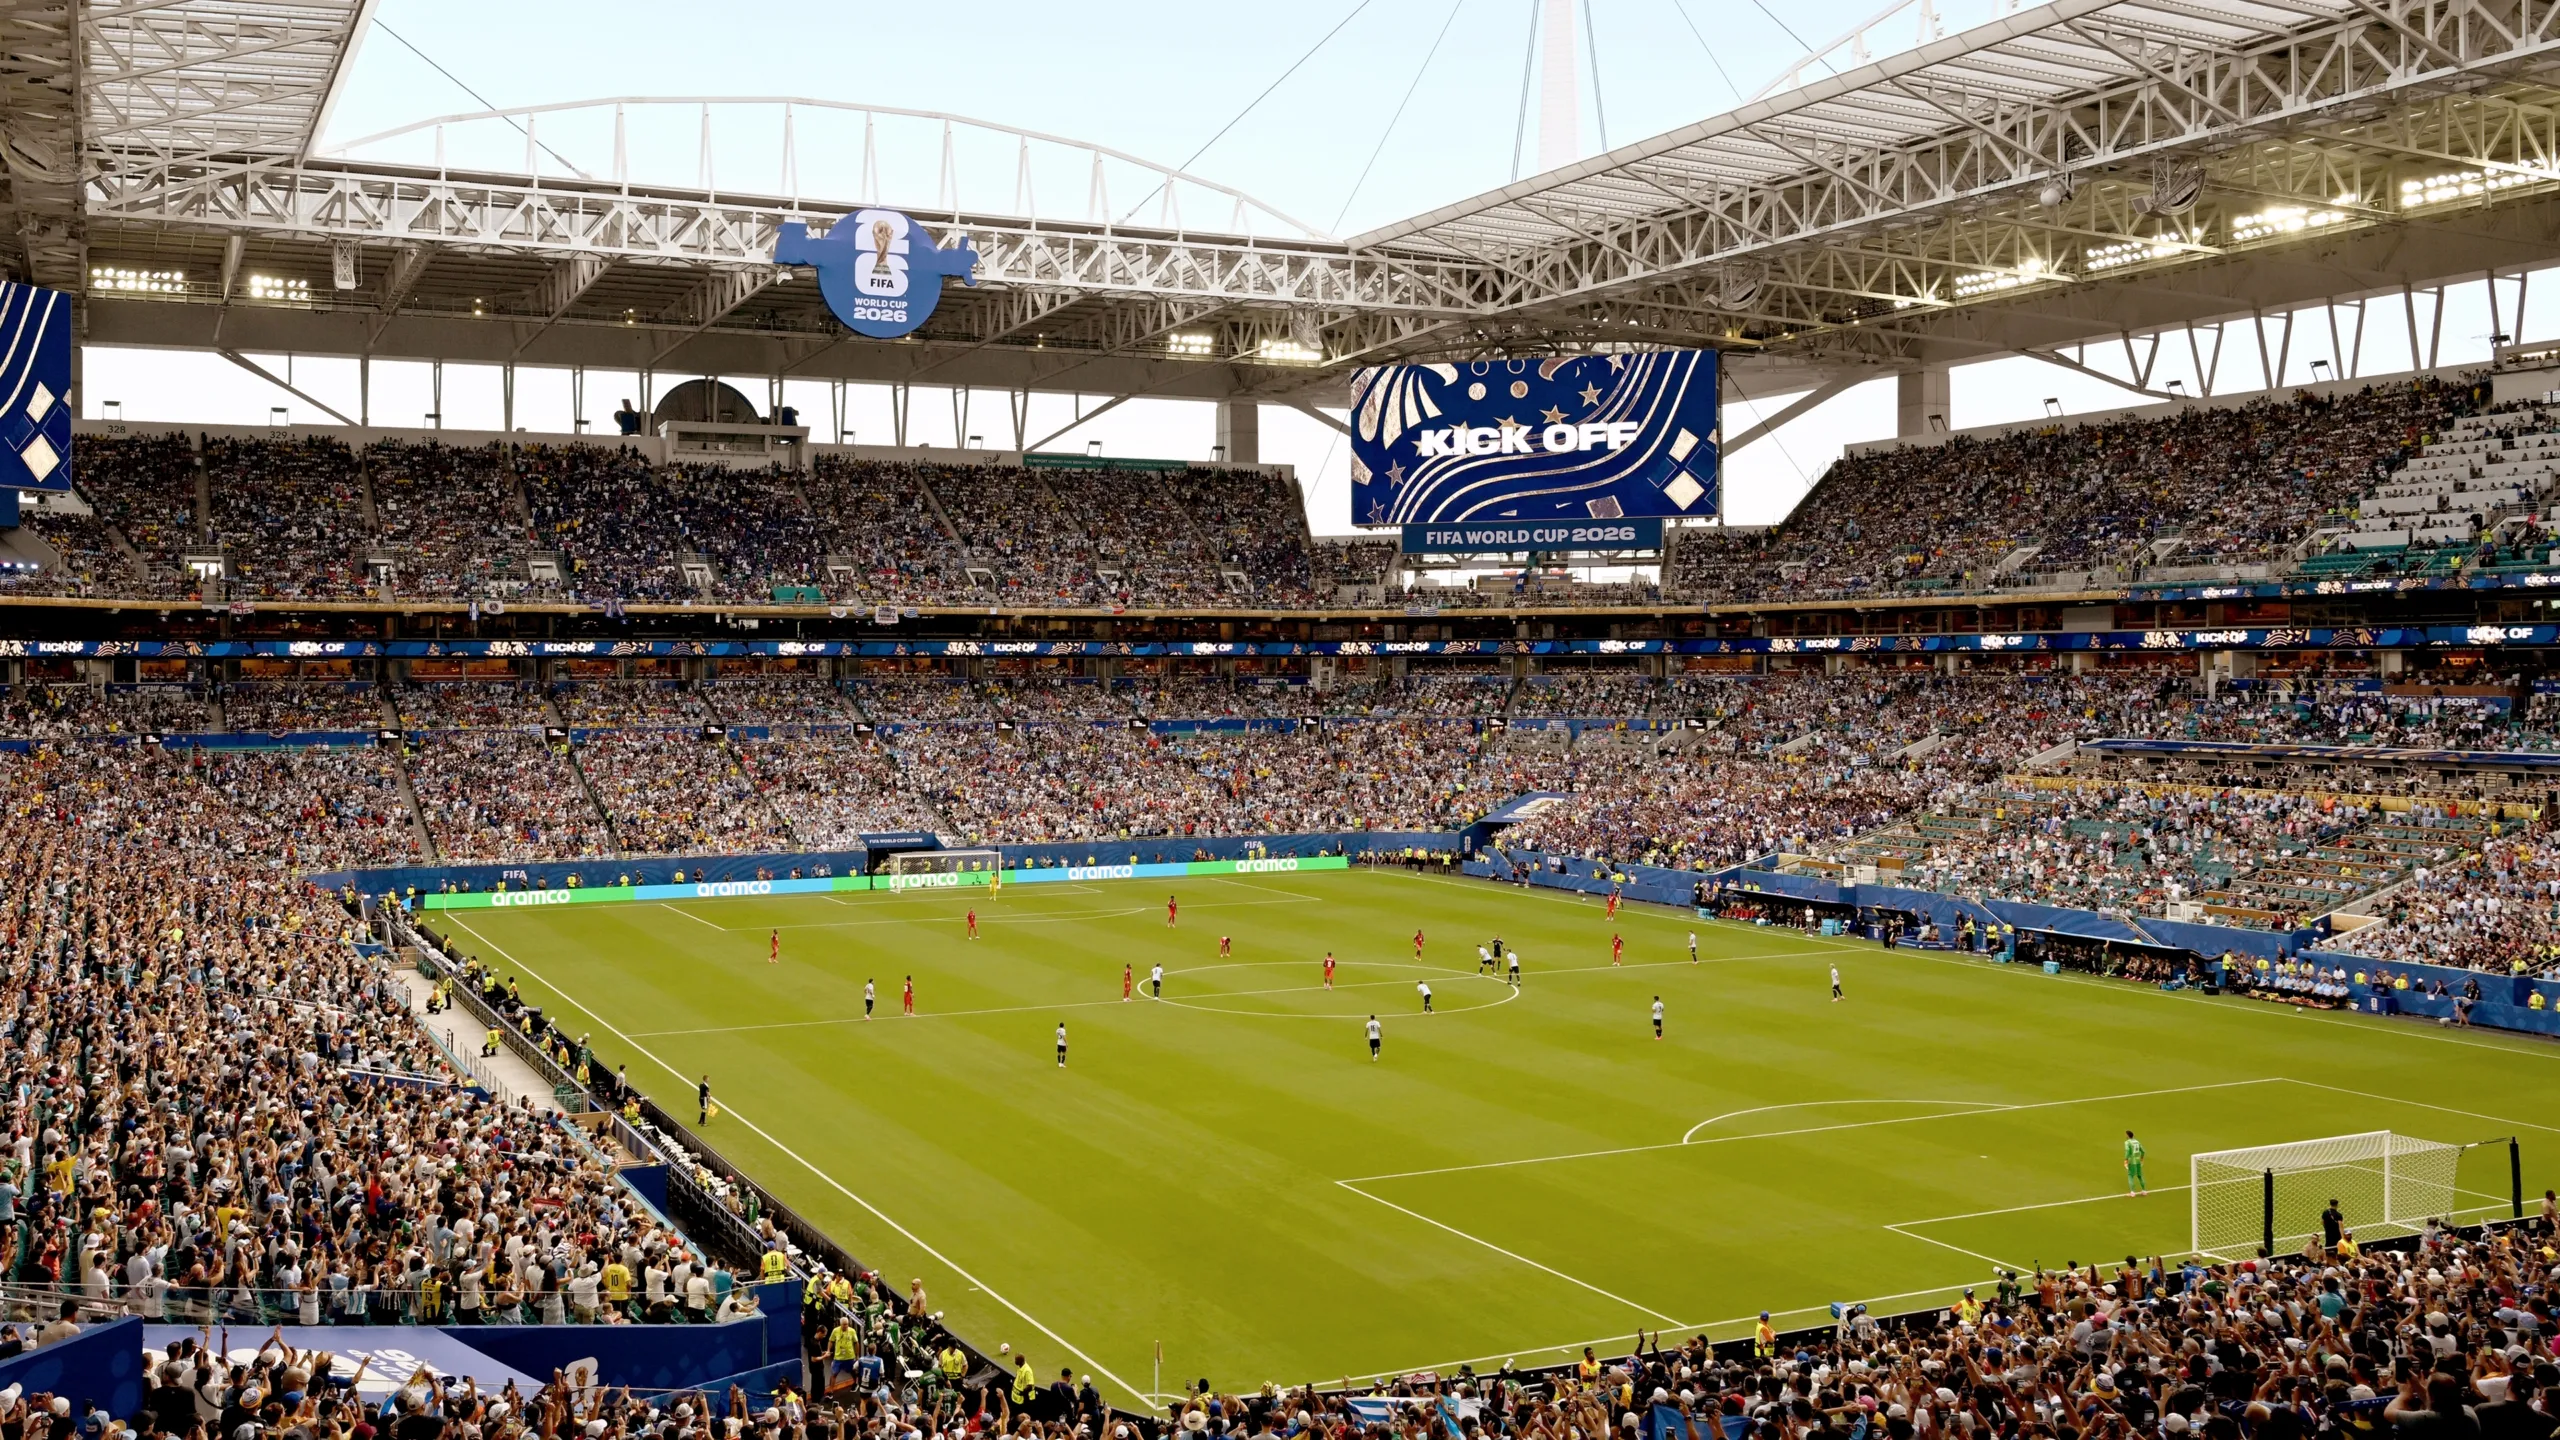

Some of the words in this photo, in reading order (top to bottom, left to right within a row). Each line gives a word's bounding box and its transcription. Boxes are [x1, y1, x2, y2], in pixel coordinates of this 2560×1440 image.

[870, 278, 894, 289] FIFA
[855, 297, 888, 308] WORLD
[889, 300, 908, 309] CUP
[853, 307, 908, 323] 2026
[107, 425, 126, 434] 328
[270, 430, 287, 439] 329
[1421, 425, 1534, 457] KICK
[1542, 421, 1638, 454] OFF
[1426, 531, 1463, 545] FIFA
[1465, 529, 1530, 545] WORLD
[1533, 528, 1569, 543] CUP
[1571, 527, 1636, 542] 2026
[1244, 841, 1263, 849] FIFA
[1236, 858, 1298, 873] aramco
[1547, 856, 1561, 865] FIFA
[503, 870, 527, 880] FIFA
[1068, 865, 1133, 880] aramco
[889, 872, 958, 888] aramco
[697, 881, 772, 897] aramco
[491, 888, 571, 907] aramco
[611, 1273, 619, 1287] 10
